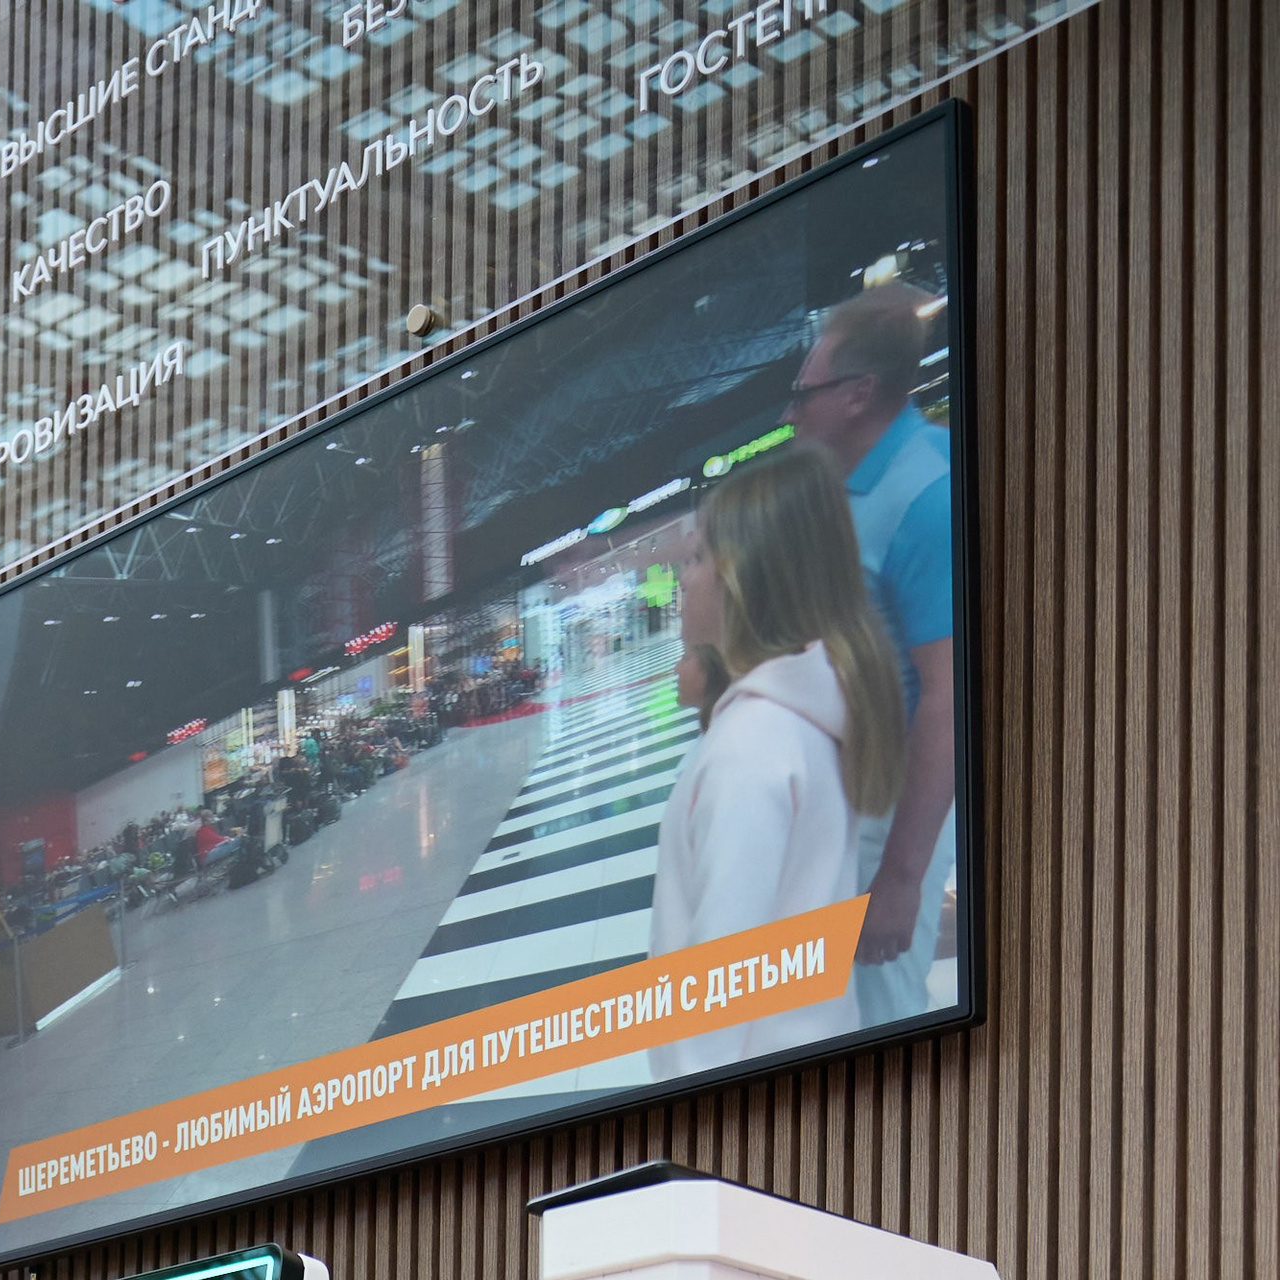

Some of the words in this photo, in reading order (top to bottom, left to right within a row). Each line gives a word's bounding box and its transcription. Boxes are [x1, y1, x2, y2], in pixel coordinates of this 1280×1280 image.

[639, 0, 828, 113] ГОСТЕП
[12, 180, 171, 302] КАЧЕСТВО
[201, 53, 544, 278] ПУНКТУАЛЬНОСТЬ
[18, 1129, 158, 1198] ШЕРЕМЕТЬЕВО
[174, 1085, 292, 1153] ЛЮБИМЫЙ
[296, 1055, 417, 1119] АЭРОПОРТ
[421, 1038, 475, 1092] ДЛЯ
[482, 974, 673, 1068] ПУТЕШЕСТВИЙ
[680, 975, 697, 1012] С
[705, 937, 826, 1013] ДЕТЬМИ
